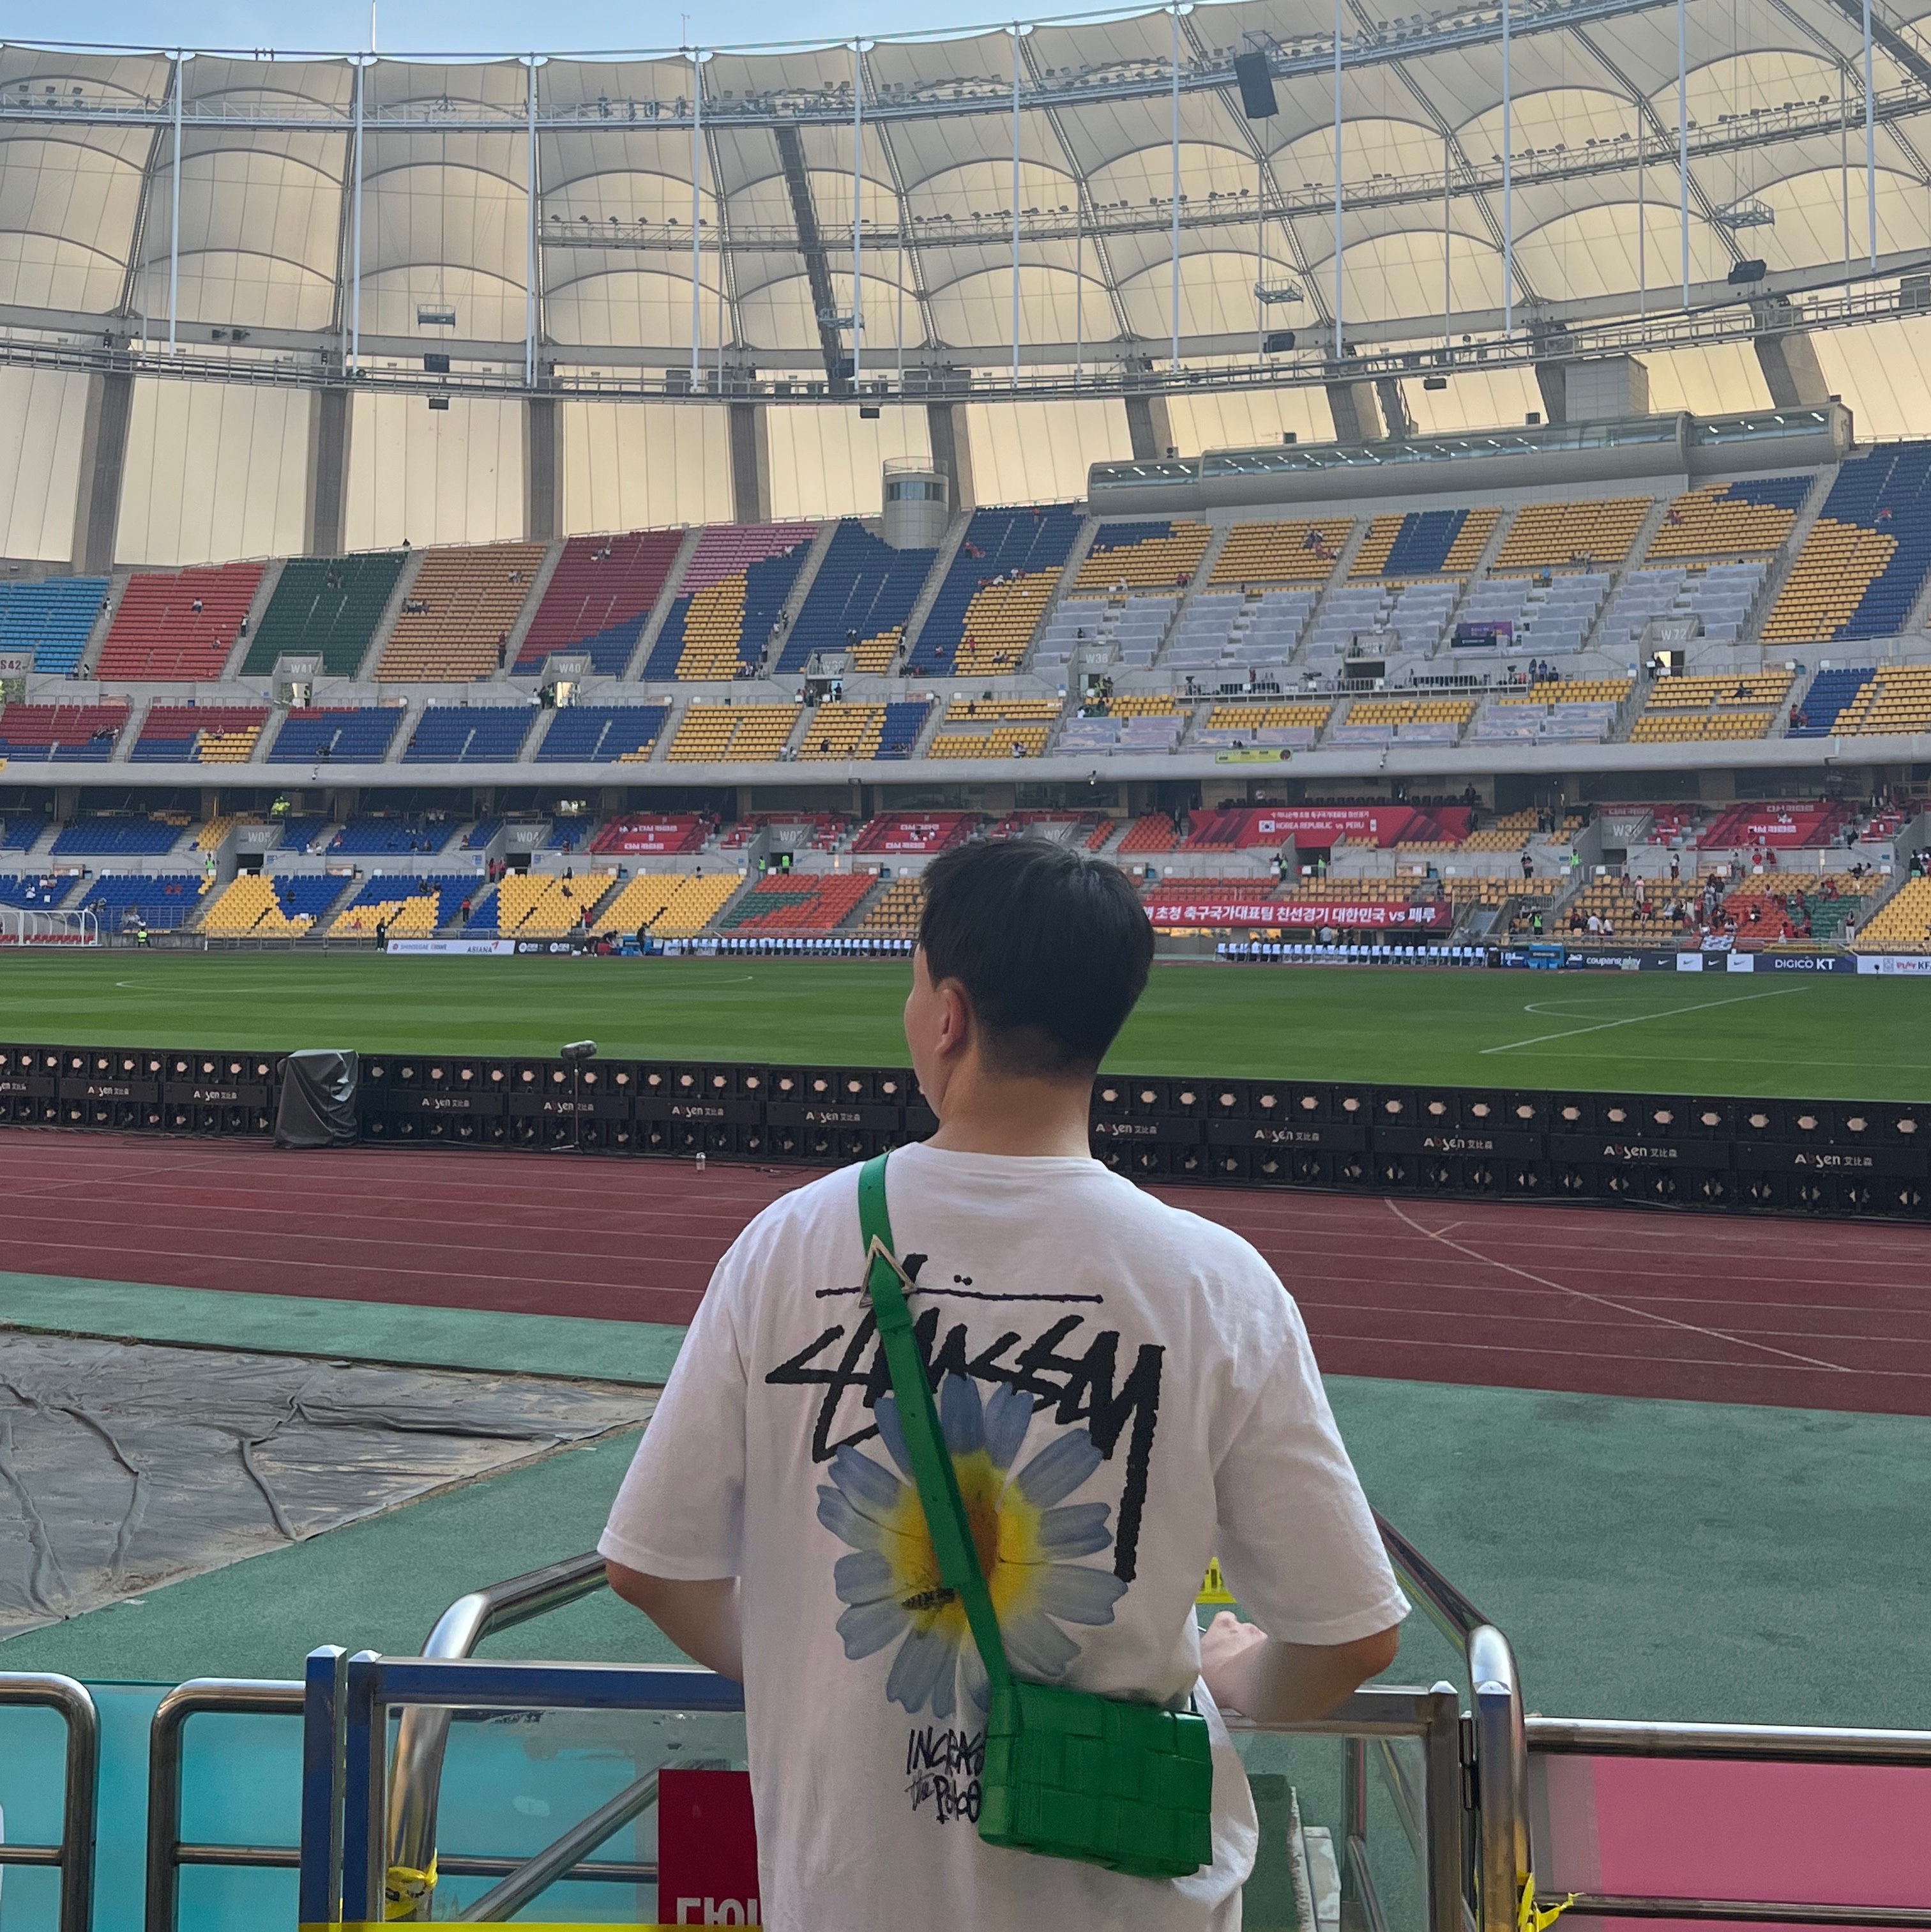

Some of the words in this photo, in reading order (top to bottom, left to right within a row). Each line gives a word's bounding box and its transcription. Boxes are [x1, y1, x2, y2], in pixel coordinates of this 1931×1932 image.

[0, 660, 21, 670] S42
[291, 664, 312, 673] W41
[559, 664, 581, 673] W40
[1155, 906, 1181, 920] 초청
[1184, 905, 1273, 921] 축구국가대표팀
[1276, 906, 1329, 922] 친선경기
[1331, 907, 1386, 923] 대한민국
[1389, 911, 1405, 922] vs
[1408, 908, 1435, 924] 페루
[1586, 957, 1622, 967] coupang
[1816, 959, 1836, 970] KT
[1918, 961, 1931, 970] KF
[1096, 1124, 1132, 1136] Absen
[1255, 1130, 1292, 1142] Absen
[1424, 1138, 1464, 1150] Absen
[1604, 1146, 1647, 1159] Absen
[1795, 1153, 1840, 1168] Absen
